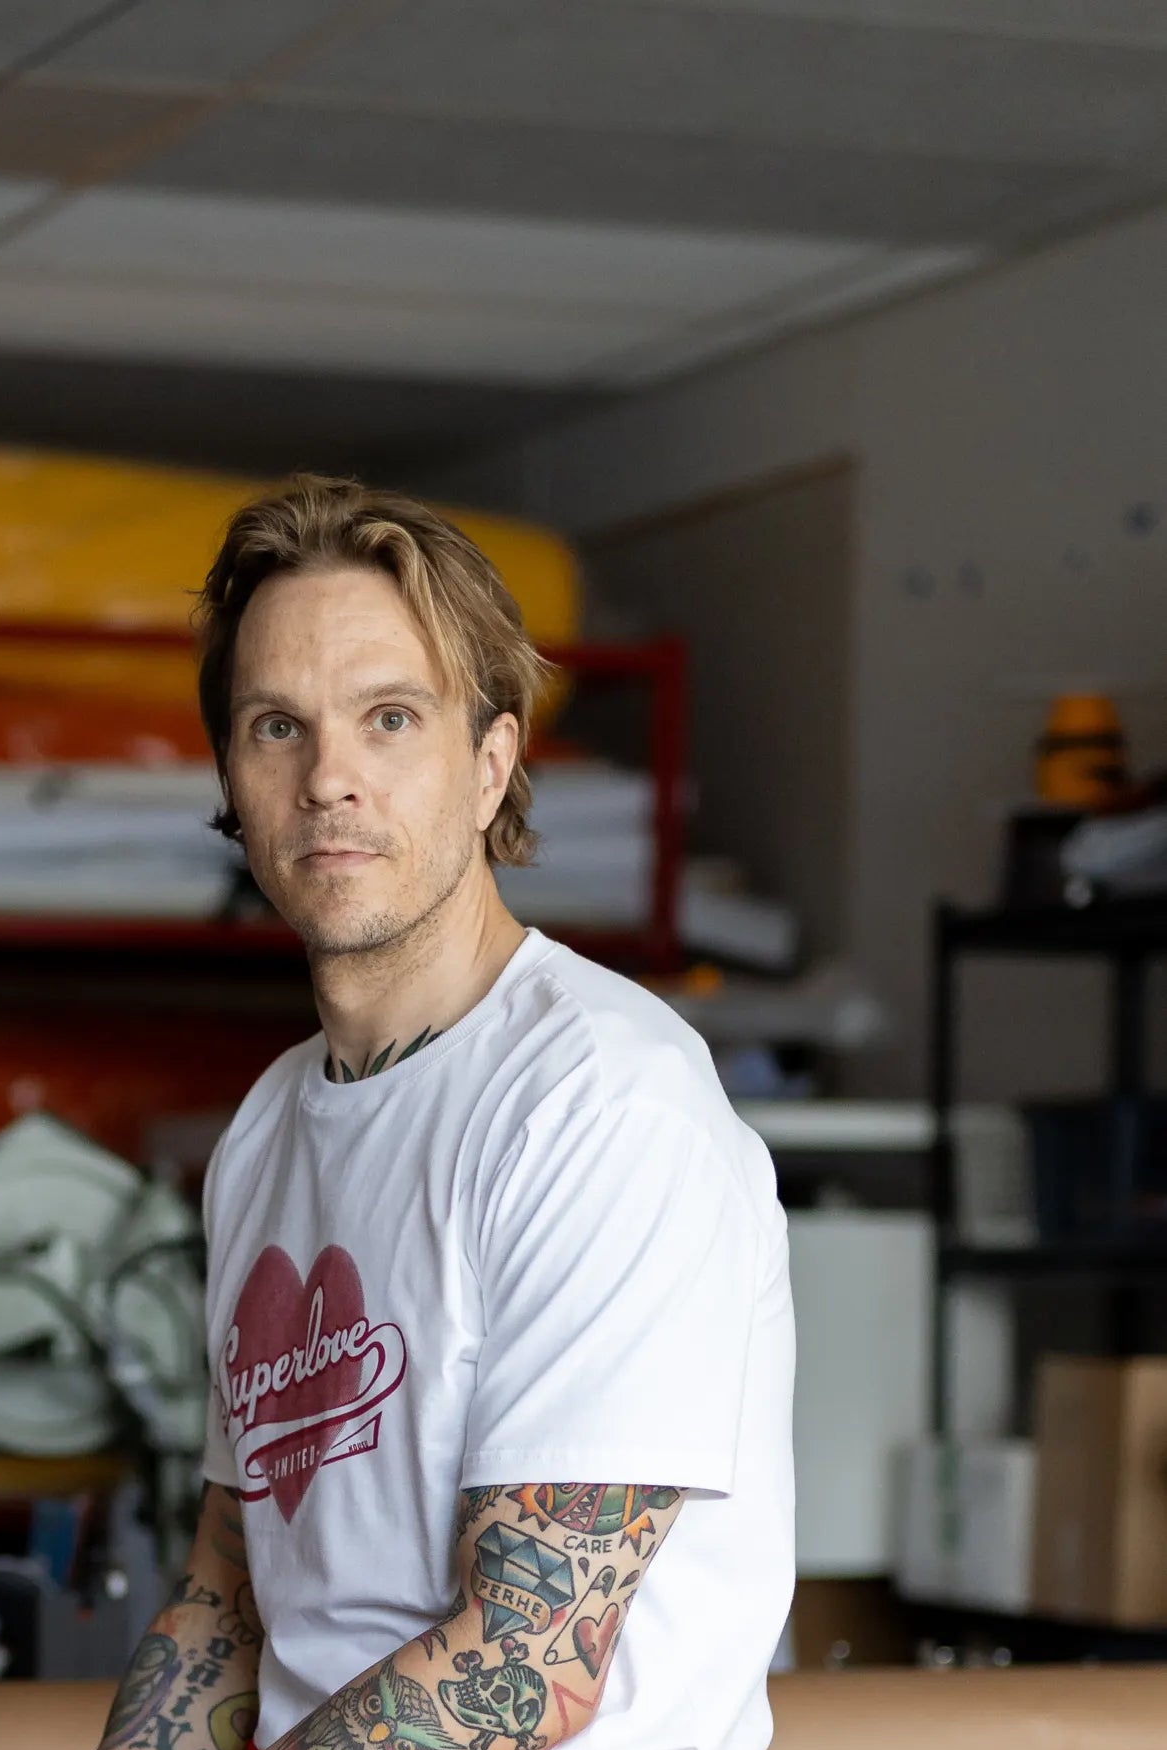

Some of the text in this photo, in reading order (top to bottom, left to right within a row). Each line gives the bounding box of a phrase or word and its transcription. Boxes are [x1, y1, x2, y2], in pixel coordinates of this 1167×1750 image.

[216, 1284, 370, 1427] Superlove
[563, 1535, 613, 1555] CARE
[477, 1580, 544, 1620] PERHE
